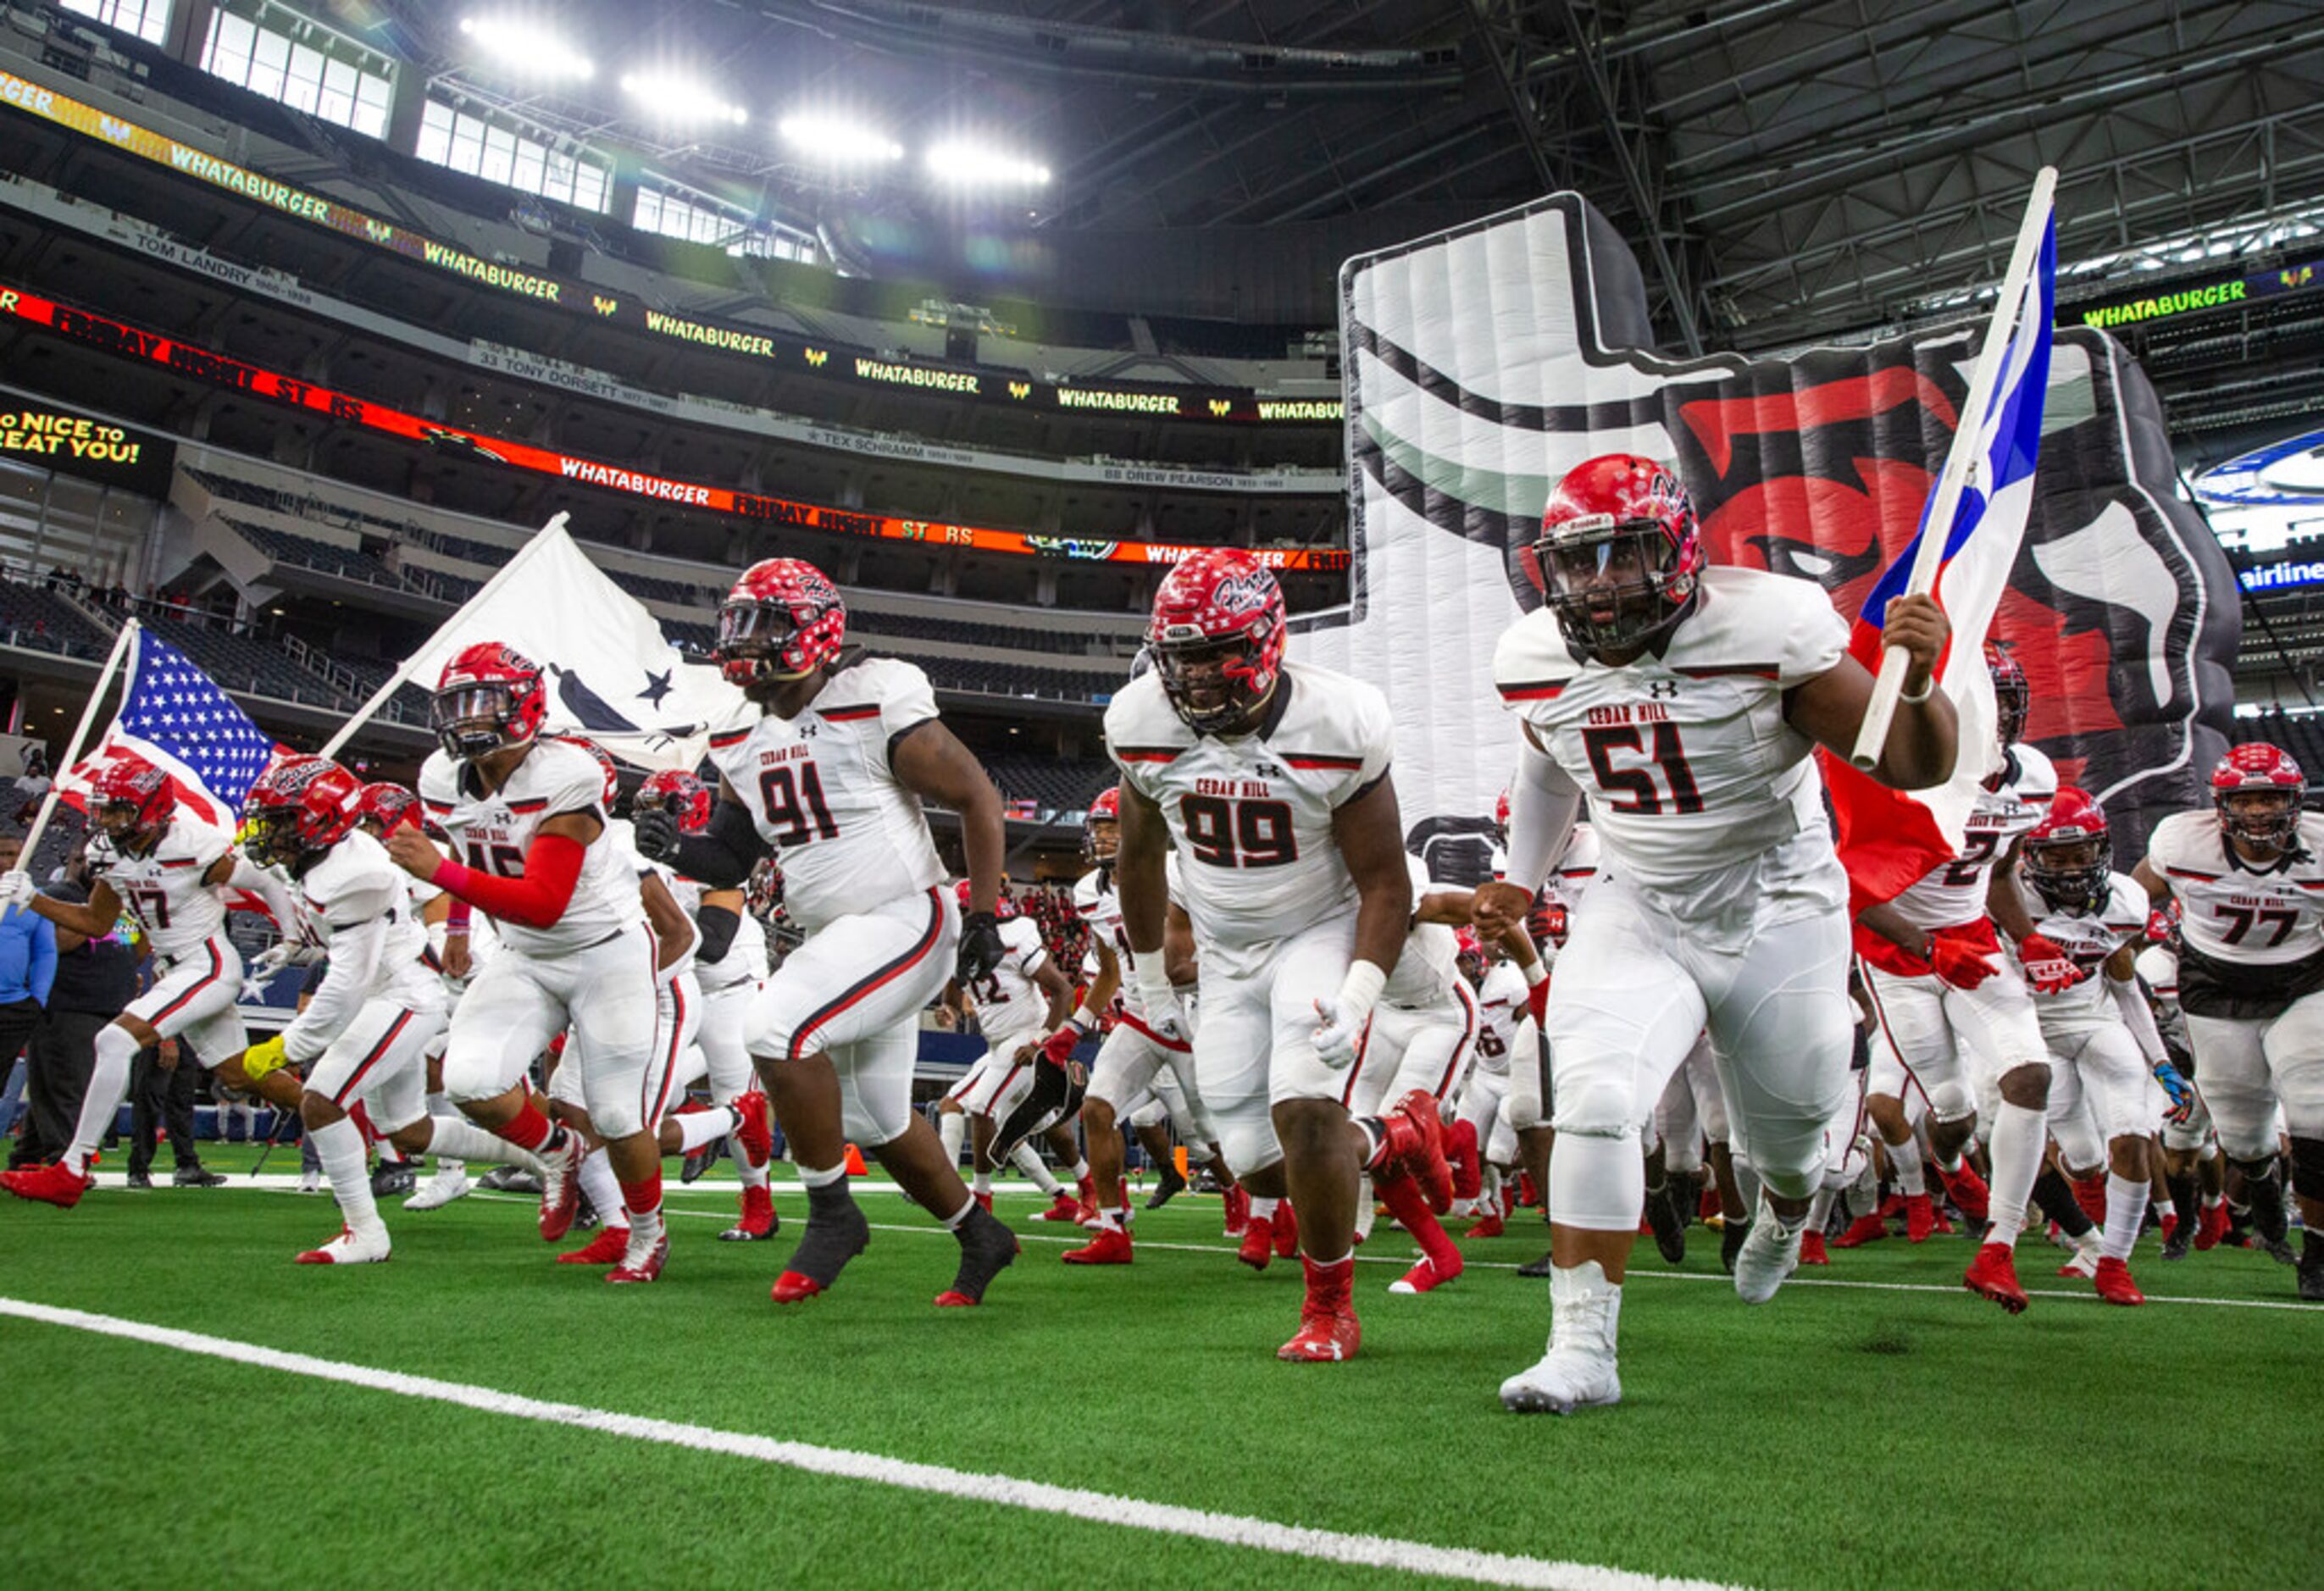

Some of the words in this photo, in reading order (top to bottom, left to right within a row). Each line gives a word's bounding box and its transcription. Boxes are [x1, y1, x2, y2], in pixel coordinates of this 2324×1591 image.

[172, 145, 328, 221] WHATABURGER
[136, 233, 176, 258] TOM
[181, 250, 251, 284] LANDRY
[424, 241, 561, 302] WHATABURGER
[2083, 280, 2246, 329] WHATABURGER
[646, 310, 774, 357] WHATABURGER
[480, 352, 498, 367] 33
[505, 358, 546, 379] TONY
[550, 371, 618, 397] DORSETT
[856, 358, 979, 393] WHATABURGER
[1057, 388, 1179, 413] WHATABURGER
[1257, 401, 1345, 420] WHATABU
[22, 411, 93, 439] NICE
[95, 425, 125, 443] TO
[824, 433, 850, 447] TEX
[855, 439, 924, 457] SCHRAMM
[69, 437, 141, 464] YOU!
[560, 457, 709, 506] WHATABURGER
[1126, 471, 1166, 483] DREW
[1168, 473, 1234, 487] PEARSON
[1588, 706, 1630, 726] CEDAR
[1639, 703, 1669, 723] HILL
[760, 749, 788, 766] CEDAR
[790, 744, 809, 761] HILL
[1582, 721, 1704, 815] 51
[759, 761, 840, 847] 91
[1195, 778, 1236, 797] CEDAR
[1242, 780, 1270, 798] HILL
[1180, 794, 1299, 868] 99
[127, 889, 171, 930] 17
[2230, 895, 2260, 907] CEDAR
[2264, 896, 2285, 907] HILL
[2215, 905, 2300, 948] 77
